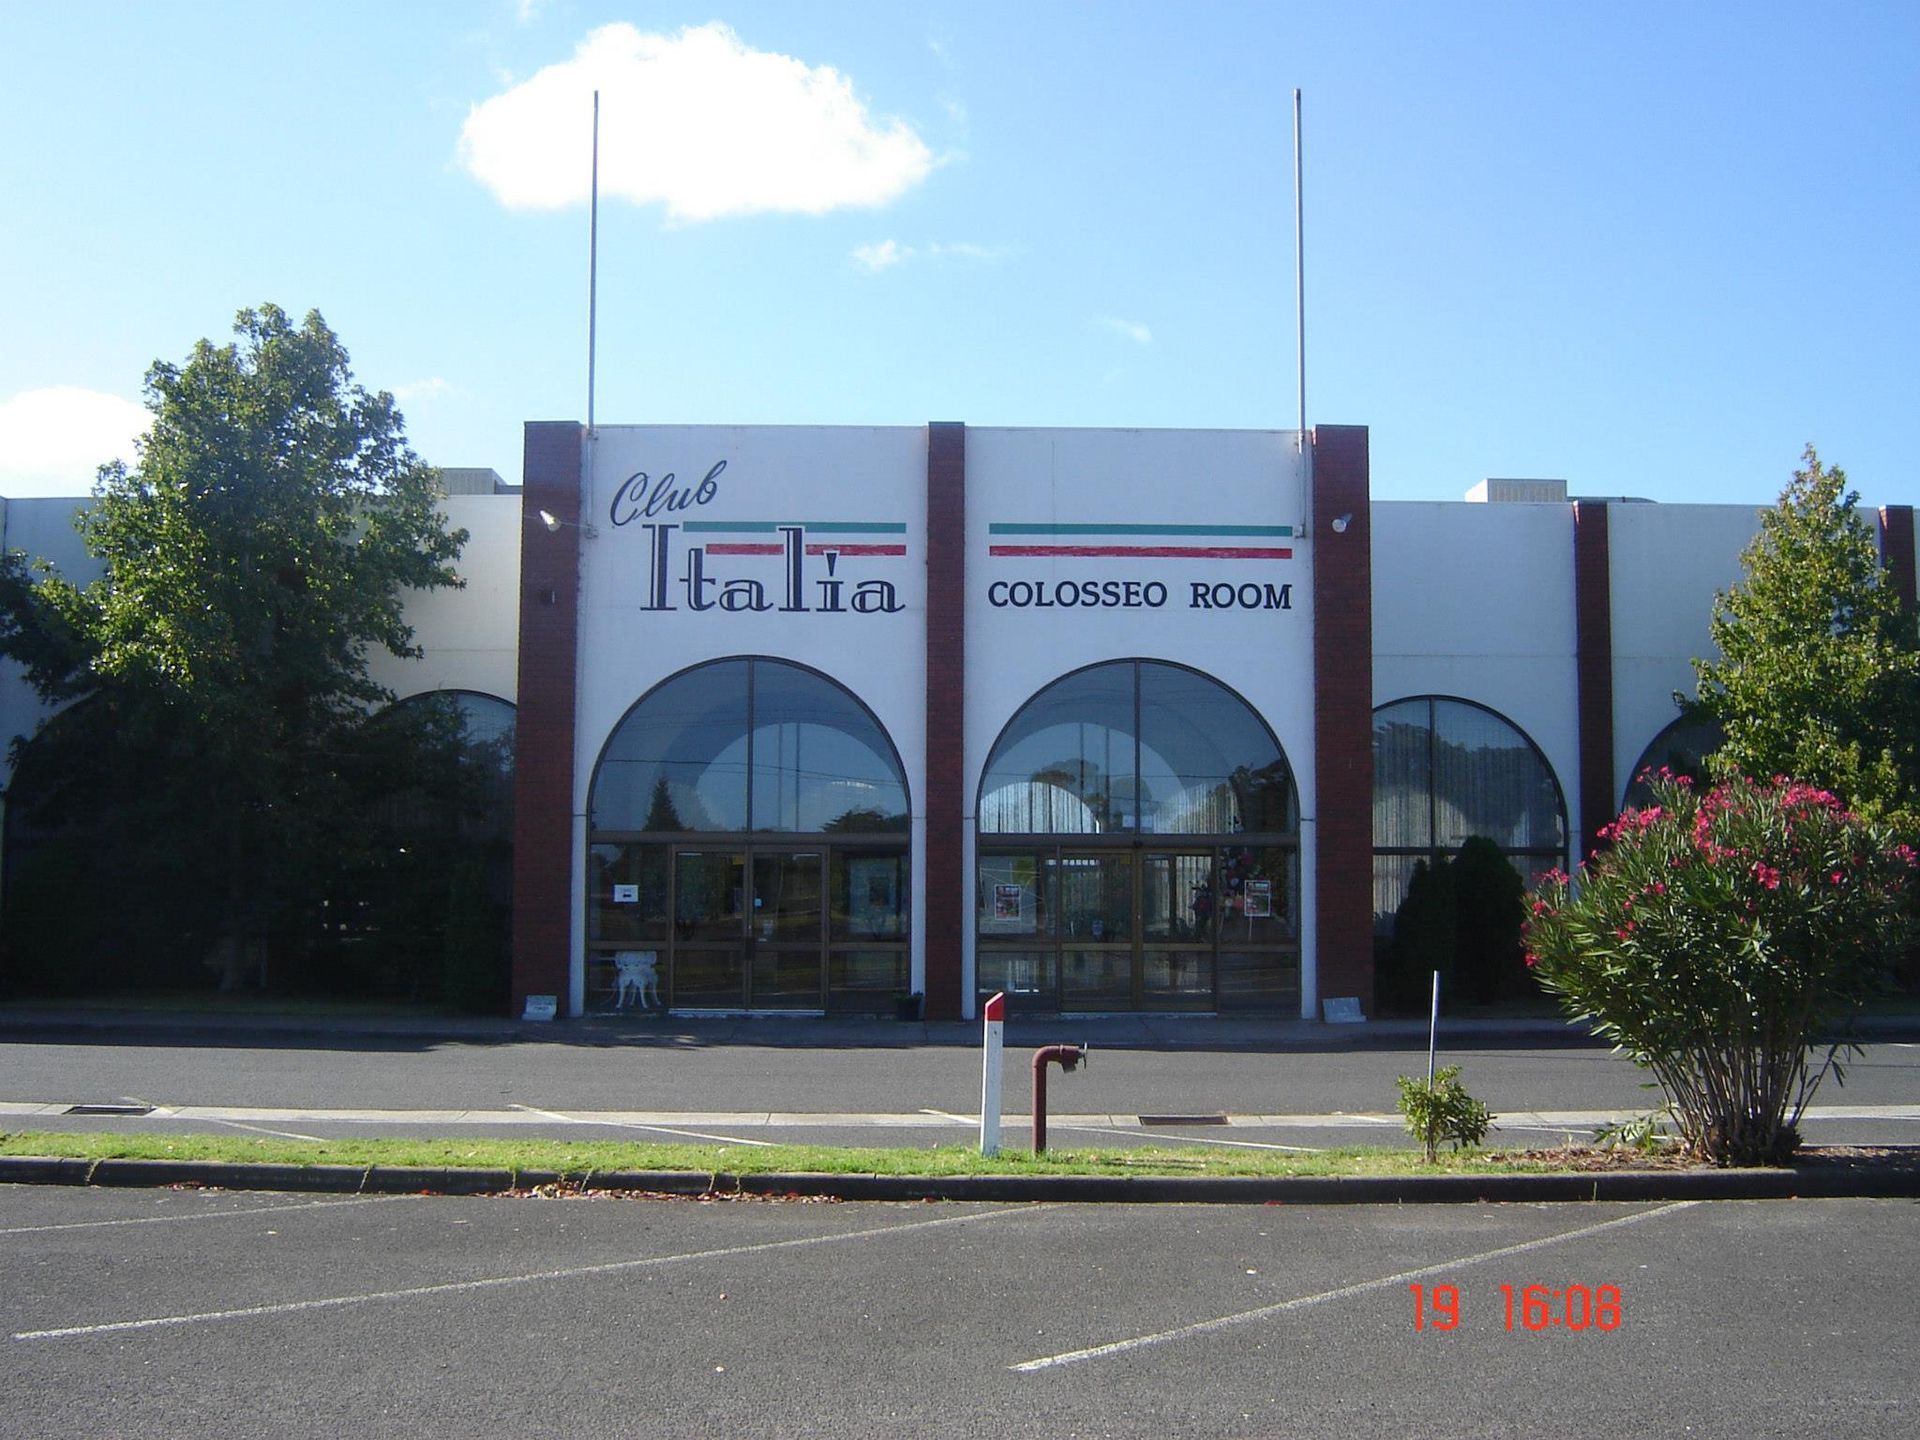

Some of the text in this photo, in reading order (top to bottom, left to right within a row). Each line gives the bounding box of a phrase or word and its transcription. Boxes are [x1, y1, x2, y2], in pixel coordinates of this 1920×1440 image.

[610, 459, 727, 526] Club
[640, 523, 907, 613] Italia
[988, 580, 1293, 610] COLOSSEO ROOM
